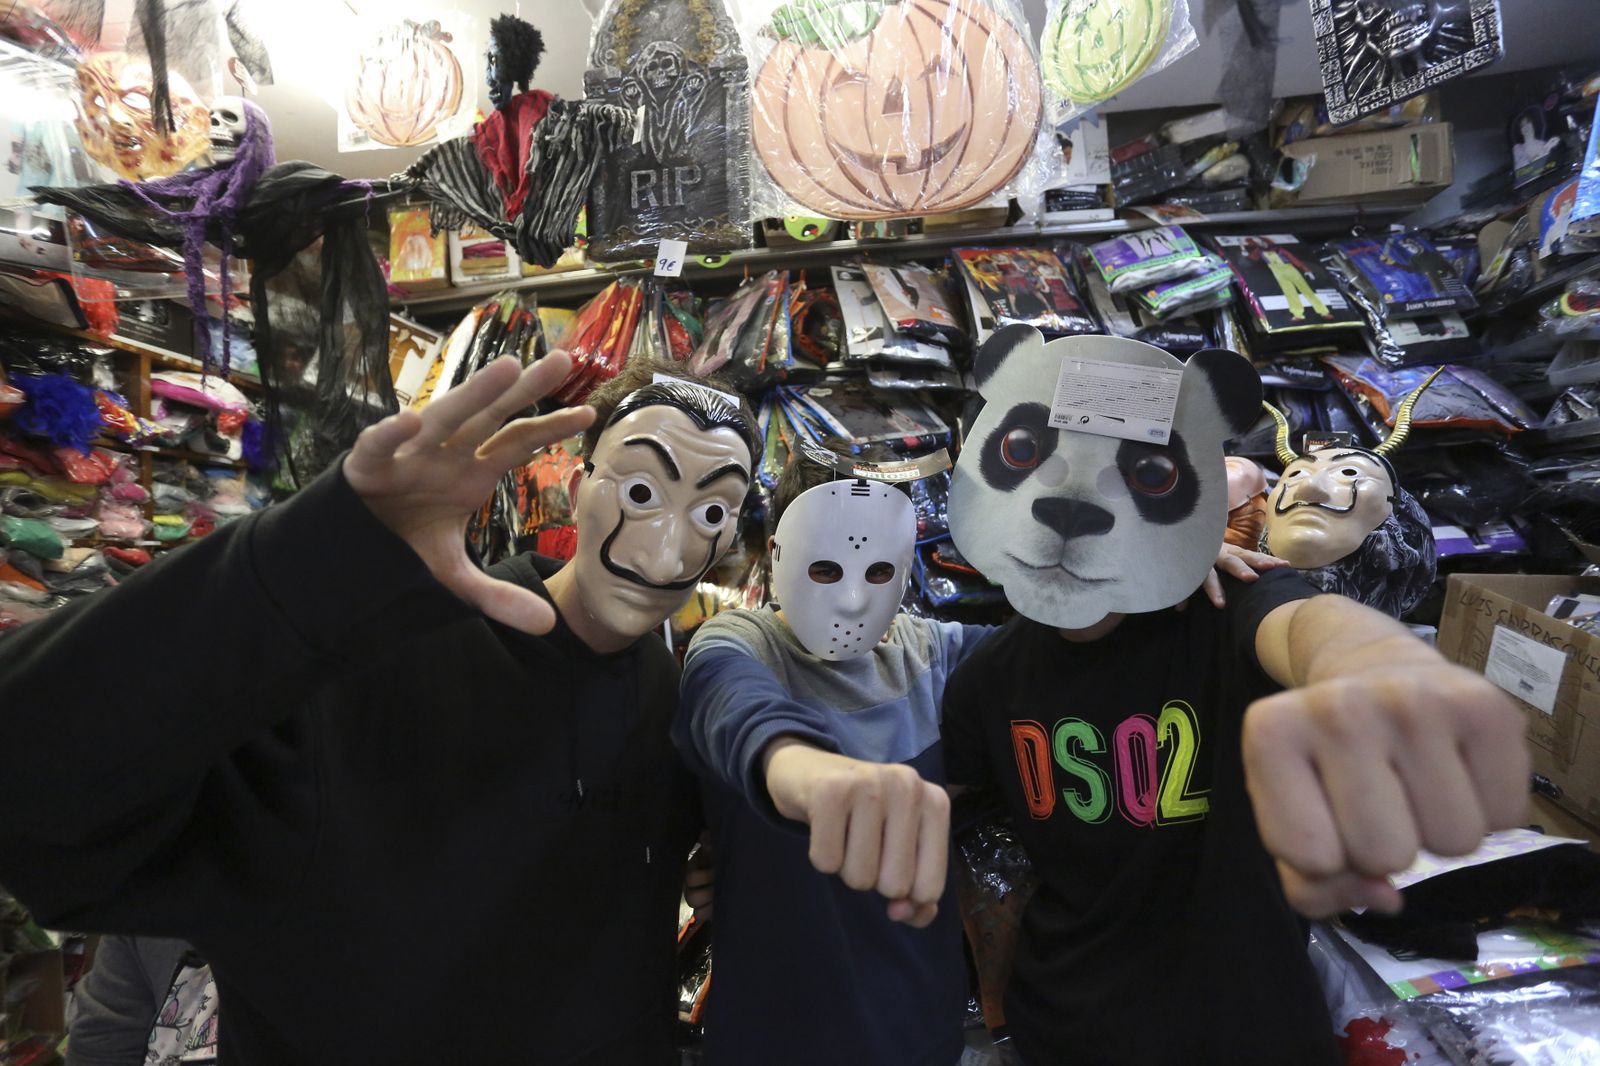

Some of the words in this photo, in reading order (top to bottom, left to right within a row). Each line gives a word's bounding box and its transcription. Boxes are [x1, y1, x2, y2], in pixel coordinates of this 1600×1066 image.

[630, 164, 702, 209] RIP
[659, 258, 676, 271] 9€
[1460, 590, 1493, 617] LUIS
